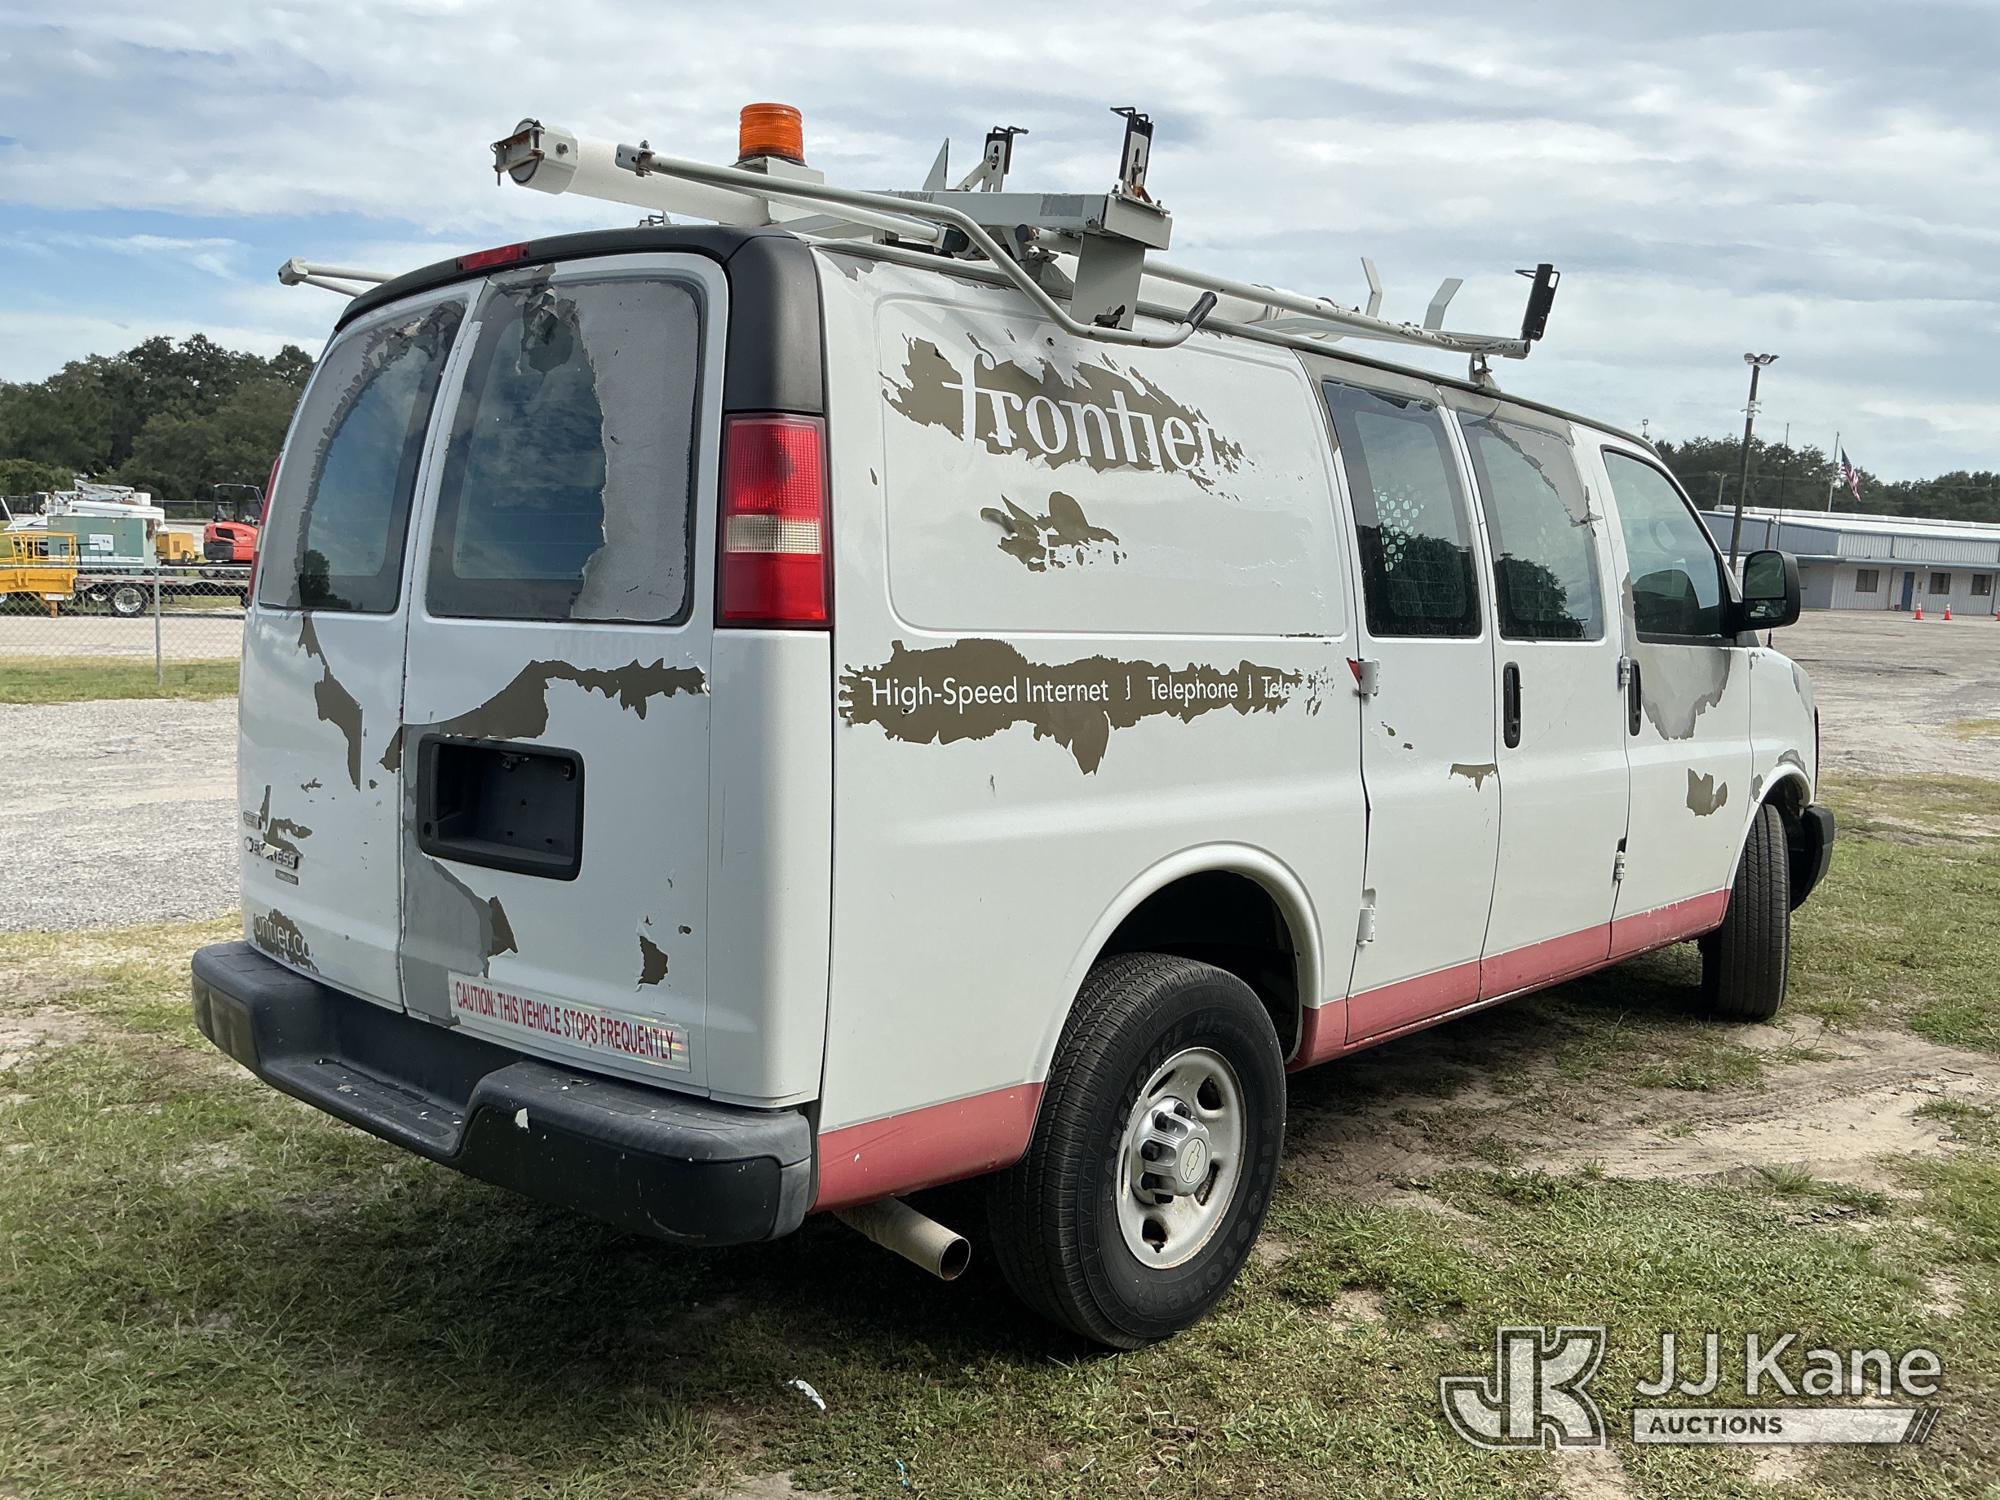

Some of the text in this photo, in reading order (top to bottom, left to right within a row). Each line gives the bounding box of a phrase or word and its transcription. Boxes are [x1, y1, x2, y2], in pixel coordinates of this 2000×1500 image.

[871, 676, 1018, 715] High-Speed
[1027, 676, 1109, 703] Internet
[1147, 673, 1238, 708] Telephone
[455, 981, 674, 1060] CAUTION: THIS VEHICLE STOPS FREQUENTLY
